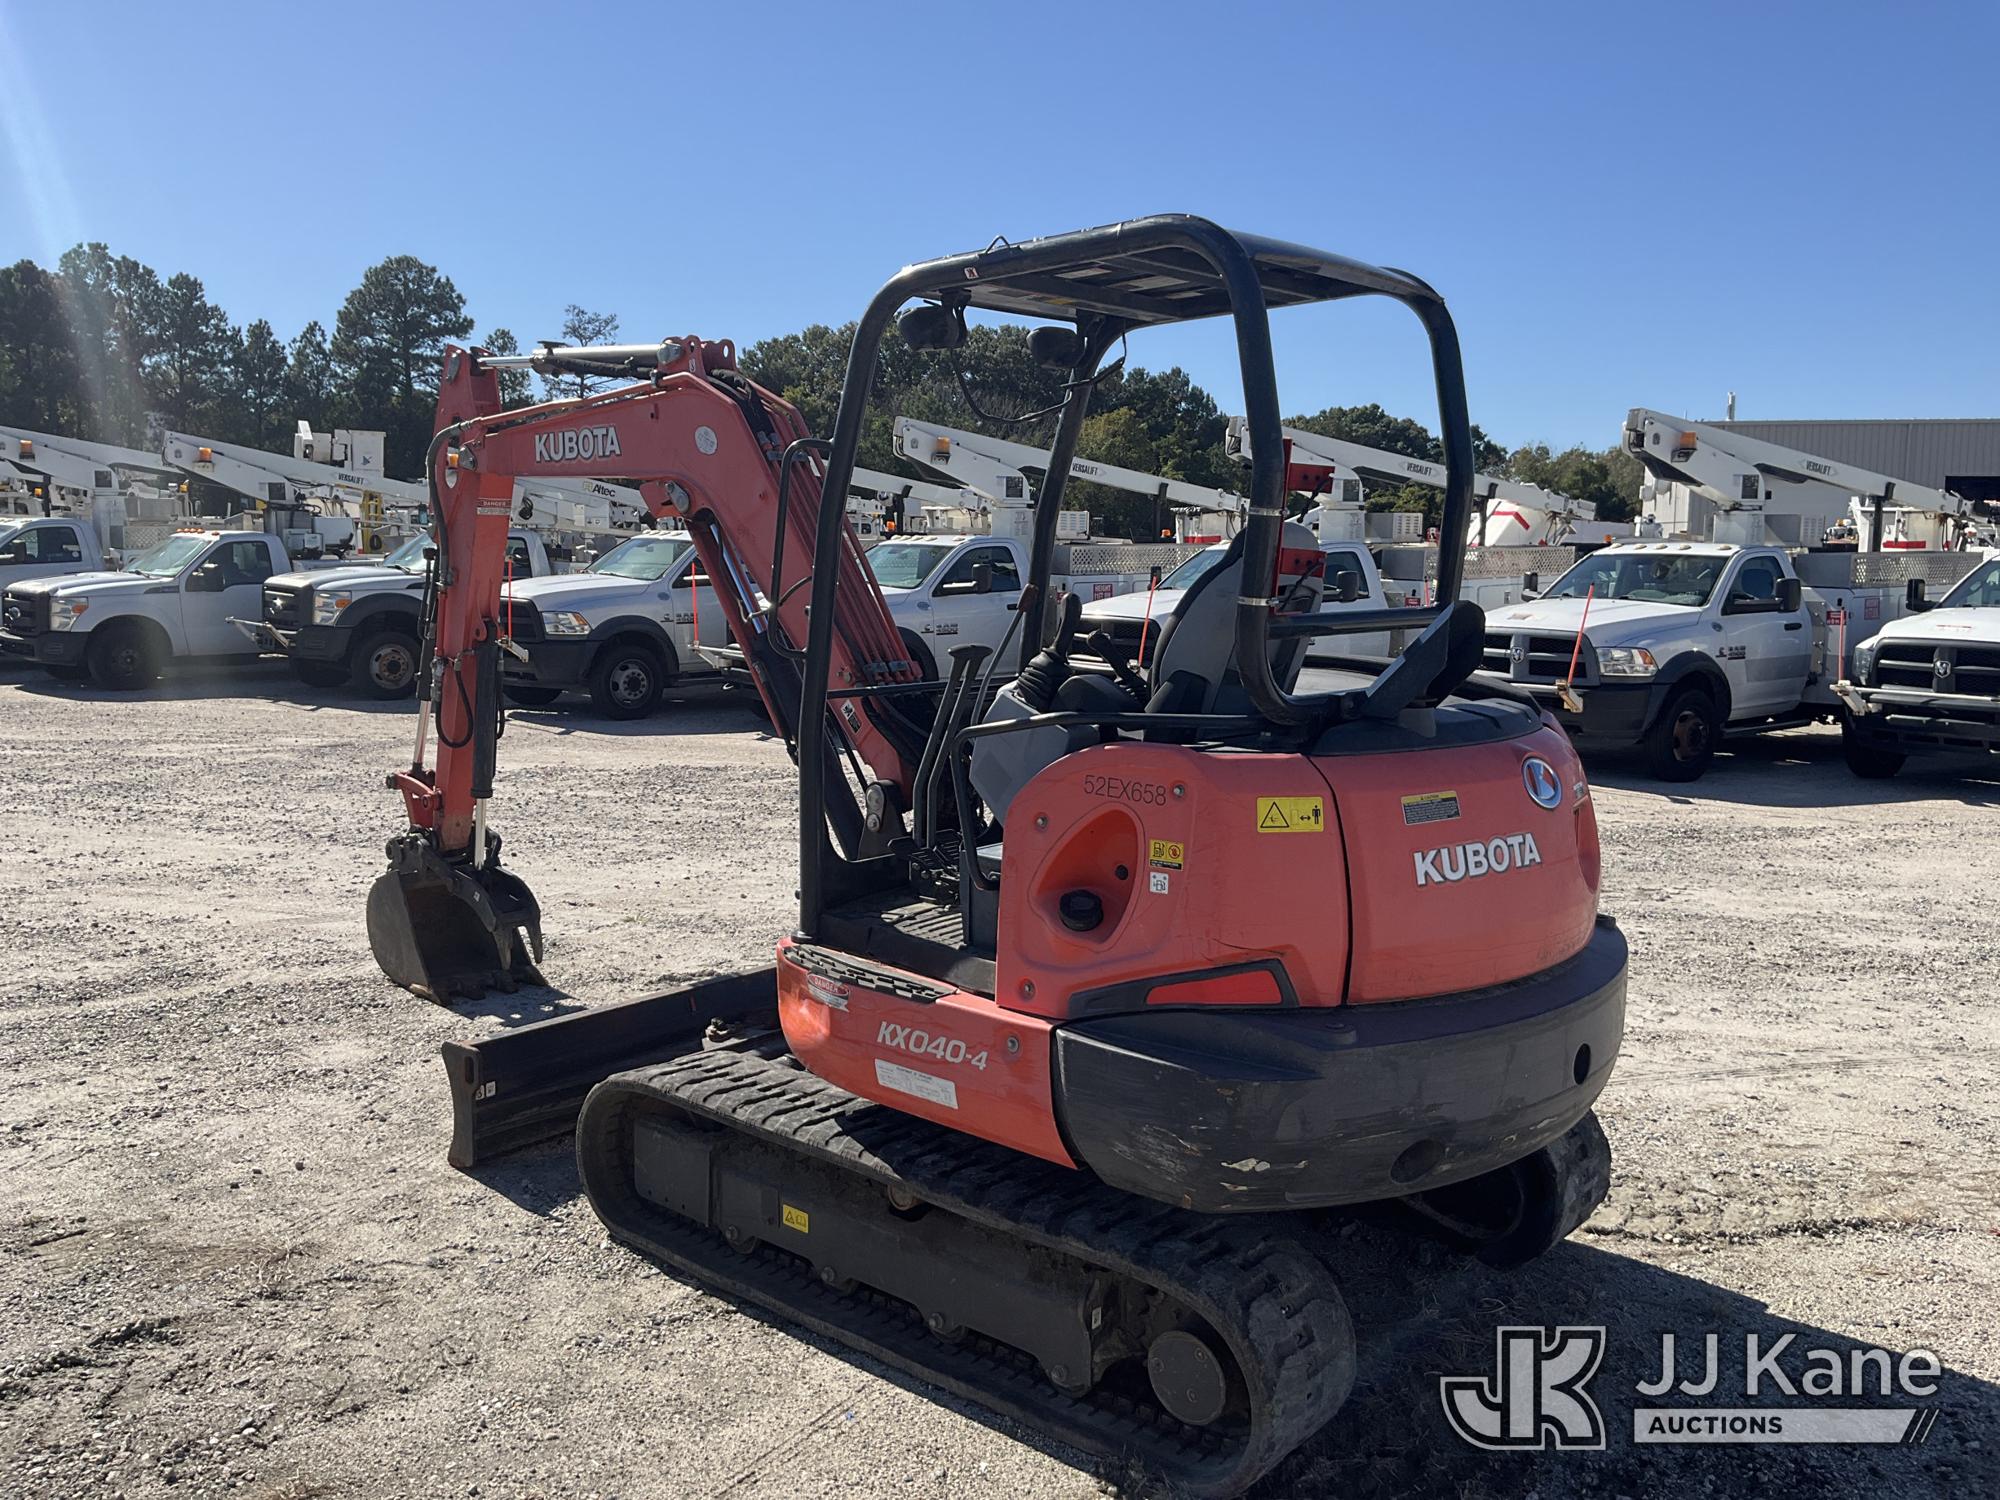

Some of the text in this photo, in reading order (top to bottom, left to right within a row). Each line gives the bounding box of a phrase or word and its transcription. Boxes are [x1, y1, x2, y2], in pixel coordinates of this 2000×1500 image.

[534, 426, 622, 463] KUBOTA
[1072, 462, 1098, 476] VERSALIFT
[1406, 462, 1432, 476] VERSALIFT
[1806, 460, 1831, 476] VERSALIFT
[338, 472, 364, 485] VERSALIFT
[591, 483, 616, 497] Altec
[1083, 774, 1167, 807] 52EX658
[1413, 832, 1542, 886] KUBOTA
[876, 1021, 988, 1071] KX040-4
